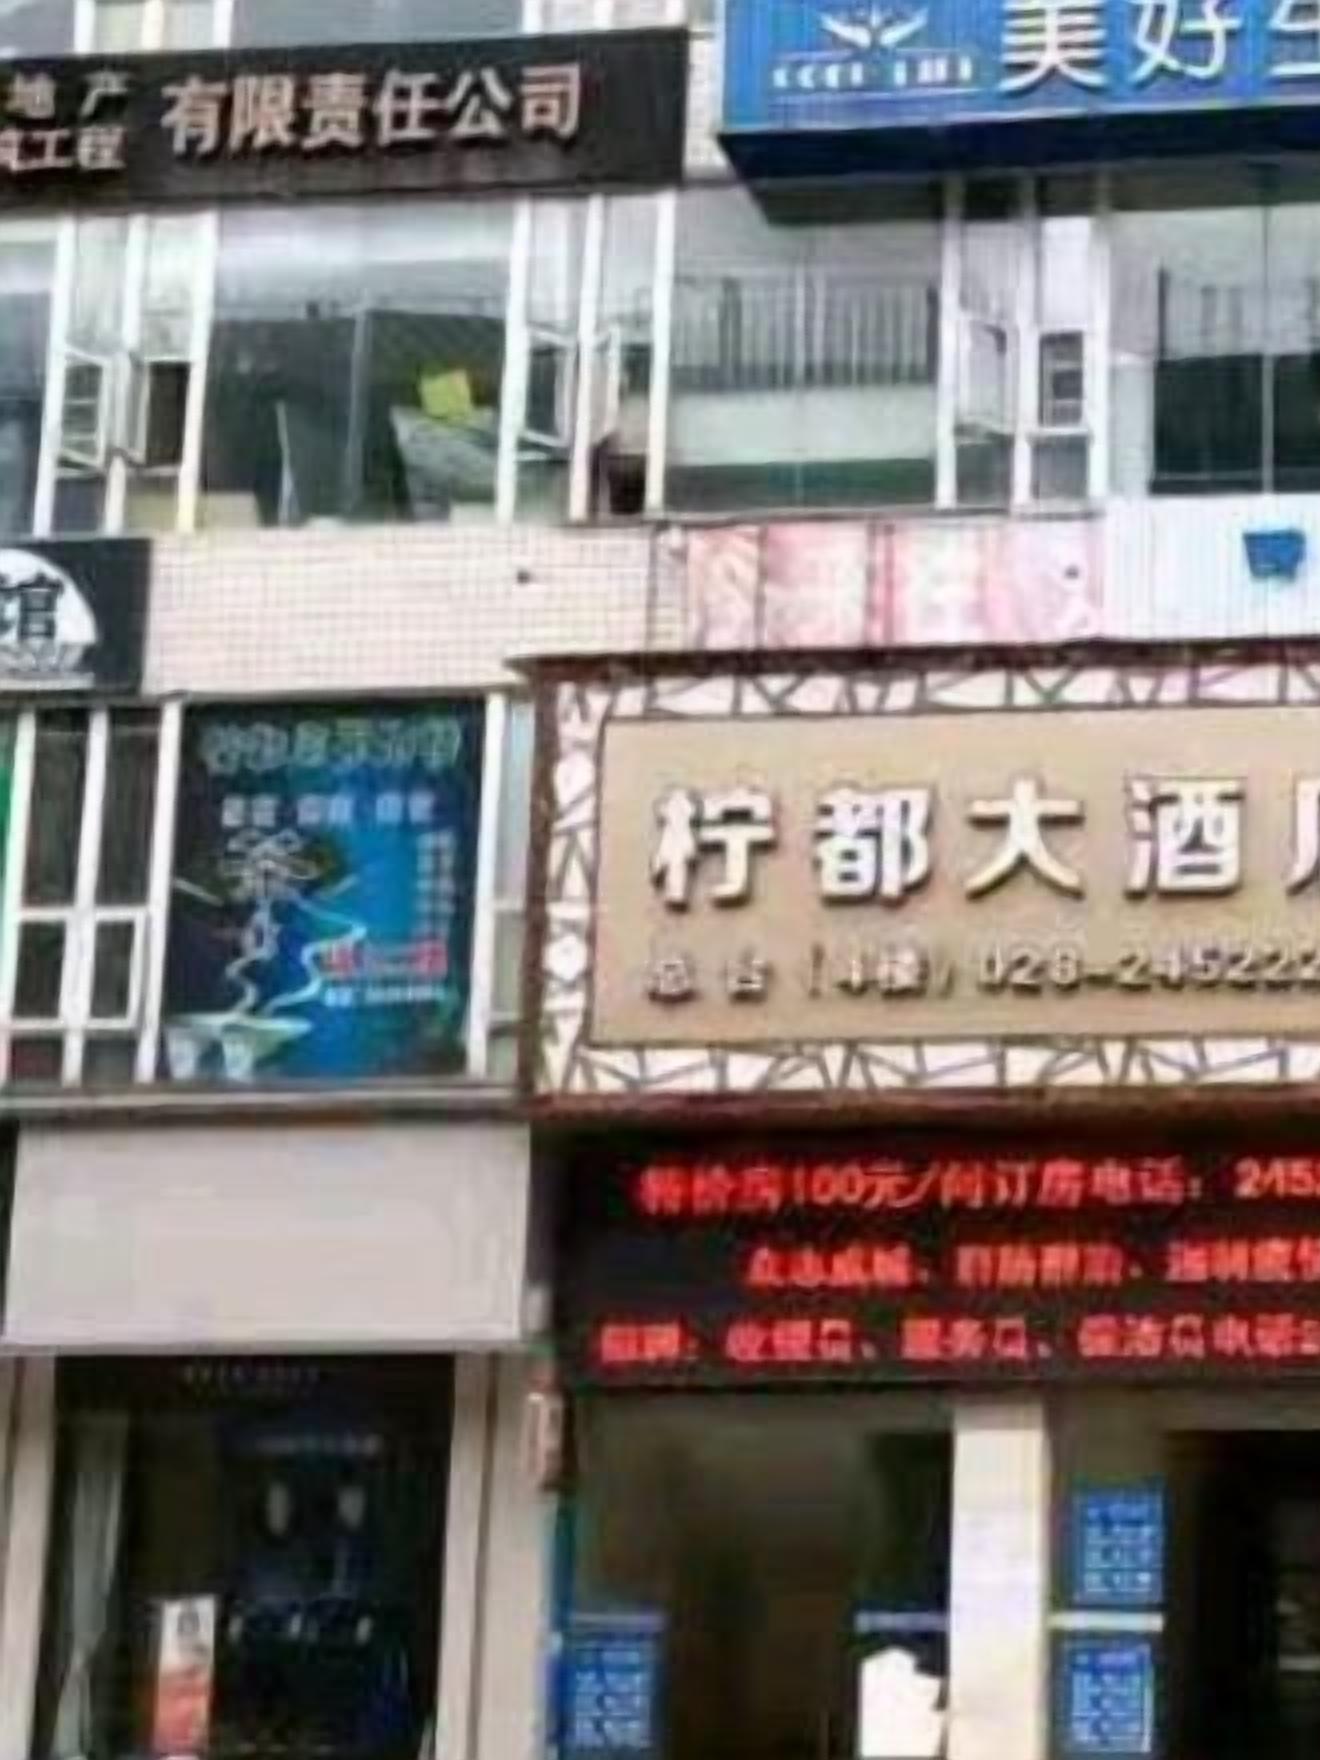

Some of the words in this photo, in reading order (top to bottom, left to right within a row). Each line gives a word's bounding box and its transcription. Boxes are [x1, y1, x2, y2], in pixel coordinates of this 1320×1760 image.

[160, 62, 580, 155] 有限责任公司
